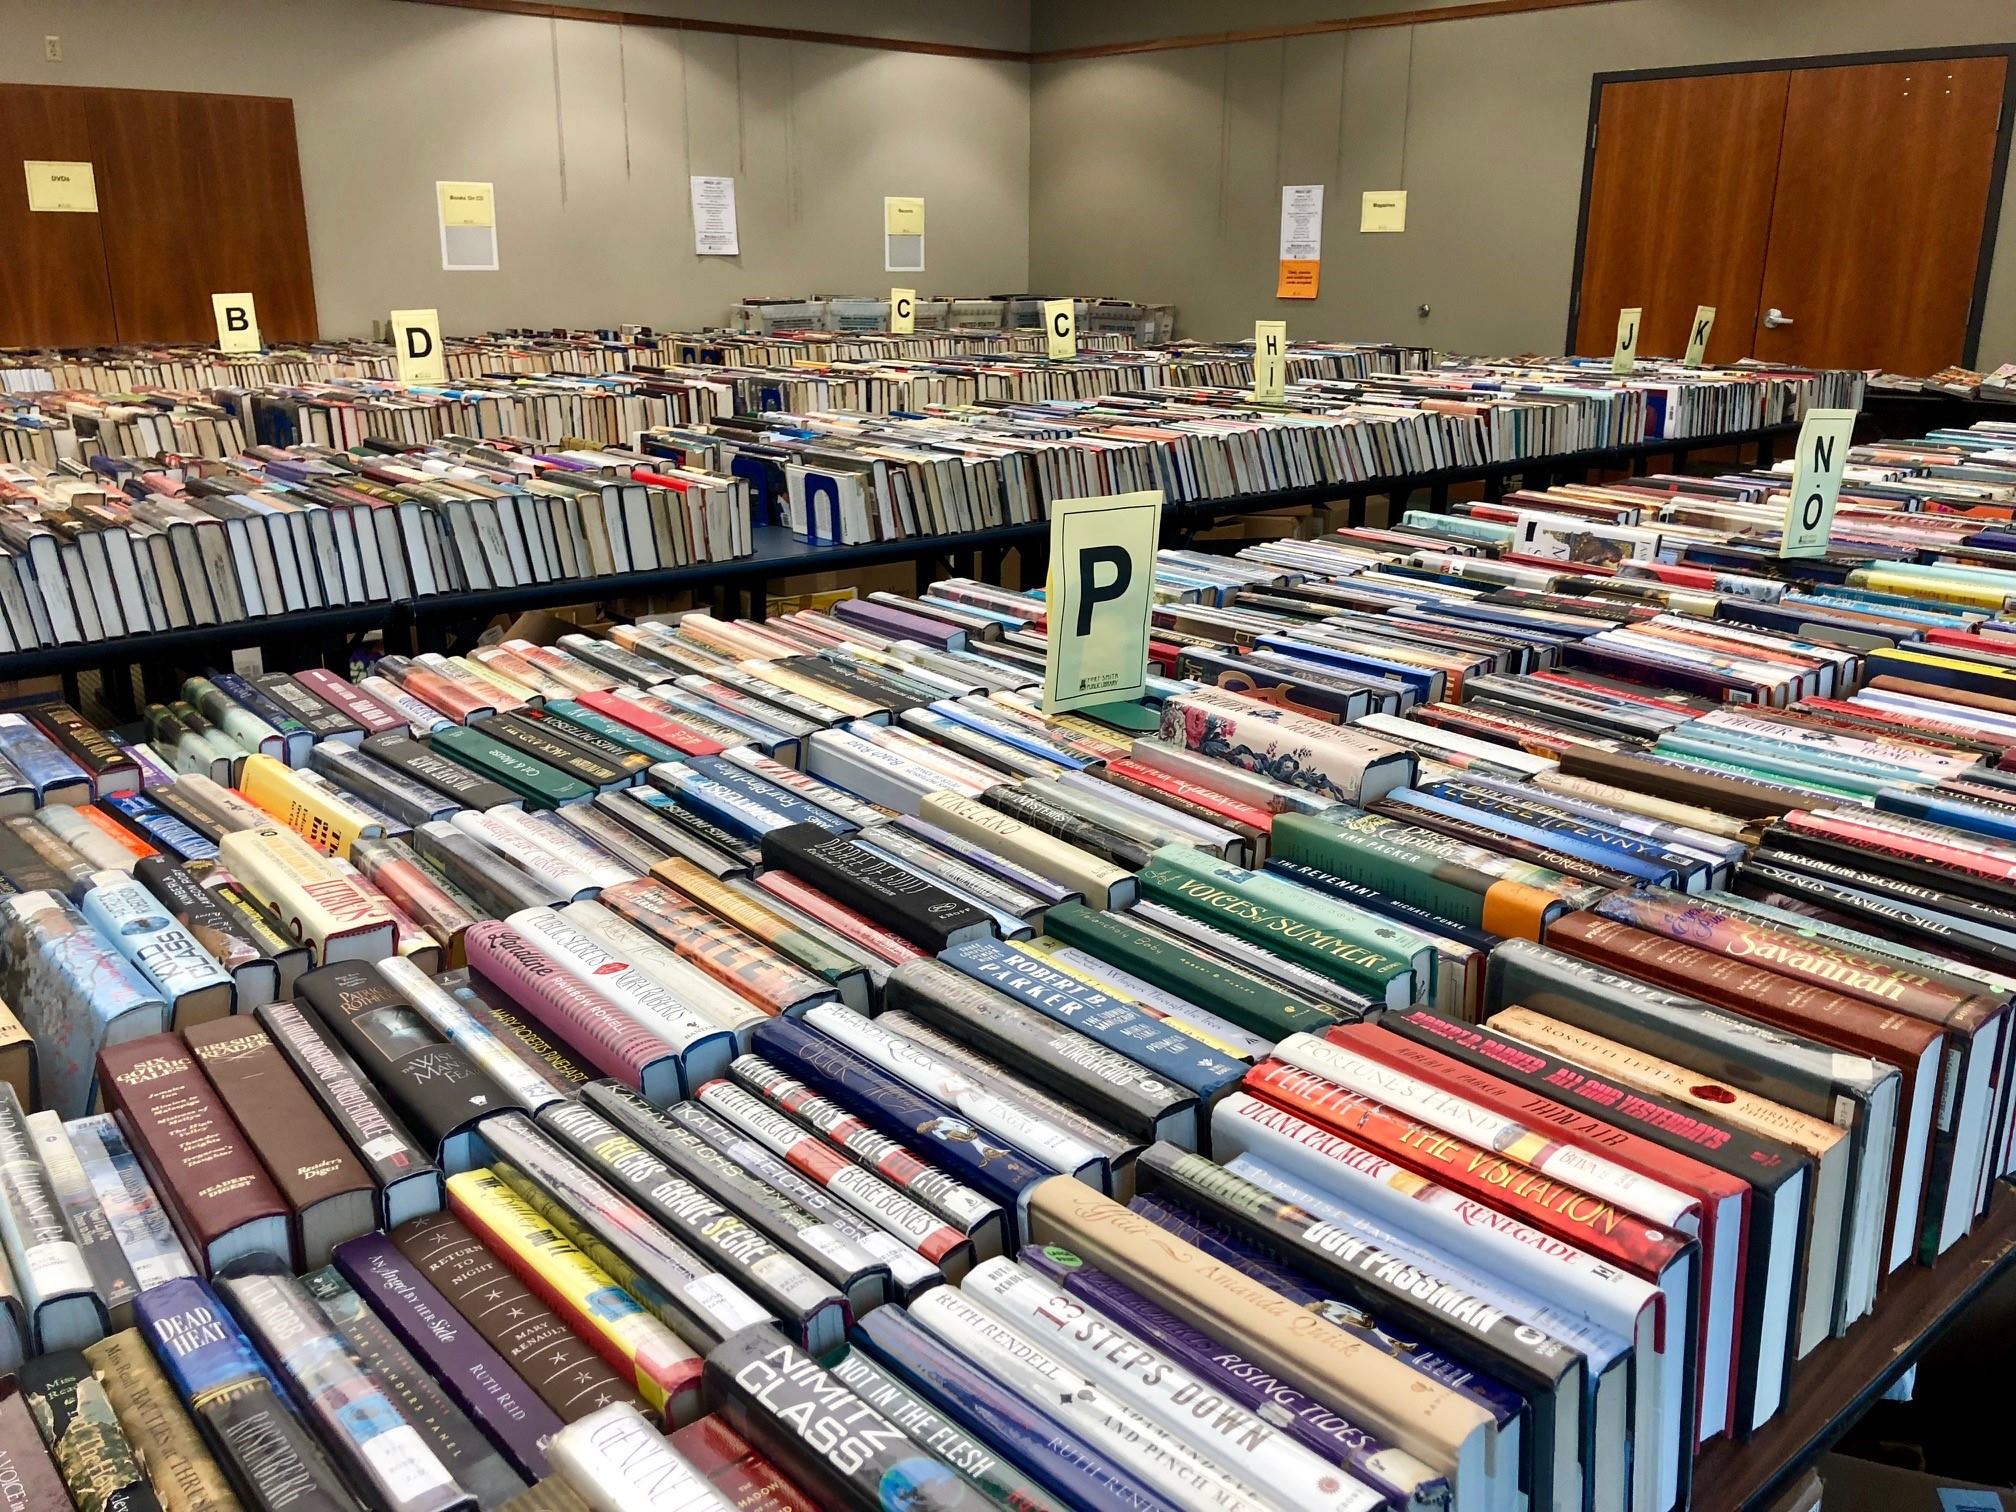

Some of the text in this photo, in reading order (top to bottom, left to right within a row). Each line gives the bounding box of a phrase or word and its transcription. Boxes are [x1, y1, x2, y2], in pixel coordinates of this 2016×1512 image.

[226, 308, 249, 331] B
[897, 299, 910, 318] C
[1054, 313, 1070, 338] C
[406, 327, 432, 358] D
[1266, 335, 1277, 355] H
[1621, 323, 1634, 351] J
[1693, 320, 1709, 346] K
[1814, 436, 1835, 473] N
[1802, 493, 1823, 530] O
[1076, 545, 1133, 637] P
[1101, 673, 1119, 682] SMITH
[489, 750, 541, 778] Mouse Cat
[544, 740, 571, 757] JACK
[713, 762, 740, 781] Mice
[744, 773, 778, 799] Blind
[776, 787, 800, 809] Four
[1466, 785, 1499, 801] OATH
[934, 792, 1022, 835] VINELAND
[1444, 788, 1650, 854] LOUISE PENNY
[814, 838, 933, 895] DEGREE OF GUILT
[1336, 830, 1422, 864] ANN PACKER
[1536, 850, 1604, 878] HORIZON
[1276, 859, 1467, 930] THE REVENANT MICHAEL PUNKE
[1772, 849, 1946, 902] MAXIMUM SECURITY
[1176, 879, 1388, 969] VOICES SUMMER
[1761, 866, 1952, 936] SECRETS STEEL
[156, 930, 219, 980] CLASS
[1071, 908, 1165, 955] Melancholy Baby
[487, 930, 627, 1036] Landline RAINBOW ROWELL
[551, 932, 689, 1022] SECRETS ROBERTS
[977, 962, 1085, 1017] PARKER
[1004, 953, 1089, 995] ROBERT
[1086, 989, 1108, 1008] B.
[1726, 933, 1907, 998] Savannah
[116, 1058, 191, 1082] GOTHIC
[133, 1056, 165, 1069] SIX
[490, 1008, 589, 1085] MARY ROBERTS RINEHART
[886, 1034, 938, 1072] QUICK
[1060, 1043, 1134, 1086] LINCOLN CHILD
[1541, 1024, 1685, 1086] ROSSETTI LETTER
[126, 1065, 189, 1085] TALES
[148, 1085, 185, 1099] Jamaica
[1294, 1039, 1501, 1135] FORTUNE'S HAND
[347, 1098, 394, 1139] EVIDENCE
[606, 1084, 744, 1178] KATHY REICHS
[1458, 1073, 1630, 1148] PARKER THIN AIR
[1616, 1091, 1731, 1151] YESTERDAYS
[297, 1159, 342, 1175] Reader's
[304, 1165, 339, 1180] Digest
[549, 1105, 726, 1226] KATHY REICHS GRAVE
[681, 1104, 832, 1209] KATHY REICHS
[710, 1084, 941, 1236] KATHY REICHS BARE BONES
[1264, 1064, 1634, 1238] PERETTI THE VISITATION
[208, 1181, 251, 1198] DIGEST
[1236, 1099, 1586, 1266] DIANA PALMER RENEGADE
[428, 1242, 484, 1273] RETURN
[450, 1261, 496, 1286] NIGHT
[453, 1258, 475, 1270] TO
[1302, 1220, 1367, 1262] DON
[1359, 1250, 1505, 1334] PASSMAN
[153, 1306, 213, 1343] DEAD
[264, 1302, 306, 1341] ROBB
[514, 1320, 550, 1341] MARY
[933, 1286, 1061, 1381] RUTH RENDELL
[1193, 1263, 1290, 1318] Amanda
[1286, 1314, 1362, 1359] Quick
[173, 1321, 229, 1357] HEAT
[373, 1263, 527, 1423] Angel HER Side RUTH REID
[509, 1324, 569, 1357] RENAULT
[46, 1375, 77, 1391] Miss
[105, 1343, 171, 1447] Miss Read BATTLES
[348, 1325, 462, 1459] THE FLANDERS PANEL
[765, 1343, 909, 1451] NIMITZ
[1033, 1295, 1086, 1333] 13
[1073, 1319, 1175, 1387] STEPS
[1170, 1382, 1274, 1453] DOWN
[735, 1359, 867, 1476] CLASS
[836, 1357, 873, 1390] NOT
[874, 1378, 896, 1402] IN
[891, 1395, 931, 1434] THE
[925, 1426, 996, 1478] FLESH
[1211, 1353, 1378, 1451] RISING TIDES
[227, 1410, 317, 1511] ROSENBERG
[1045, 1436, 1102, 1479] RUTH
[1116, 1402, 1217, 1471] ADAM AND
[1, 1456, 26, 1504] VOICE
[1098, 1414, 1247, 1512] AND PINCH ME
